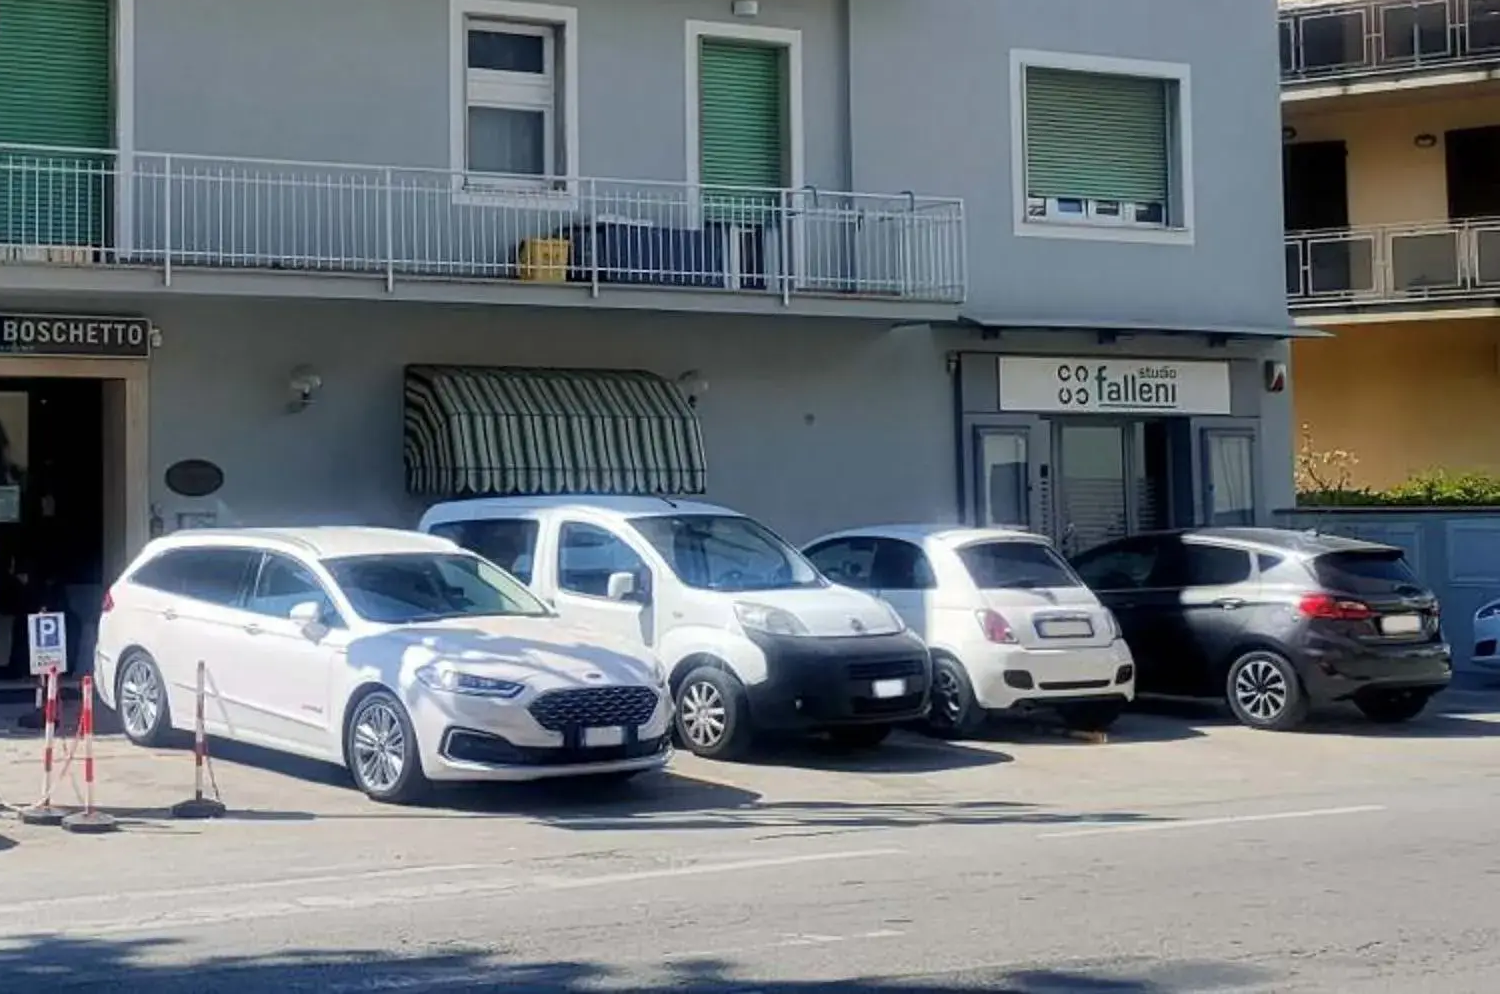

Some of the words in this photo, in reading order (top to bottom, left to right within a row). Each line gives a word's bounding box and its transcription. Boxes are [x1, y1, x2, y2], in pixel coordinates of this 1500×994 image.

[3, 320, 143, 345] BOSCHETTO
[1095, 365, 1177, 403] falleni
[40, 619, 56, 646] P
